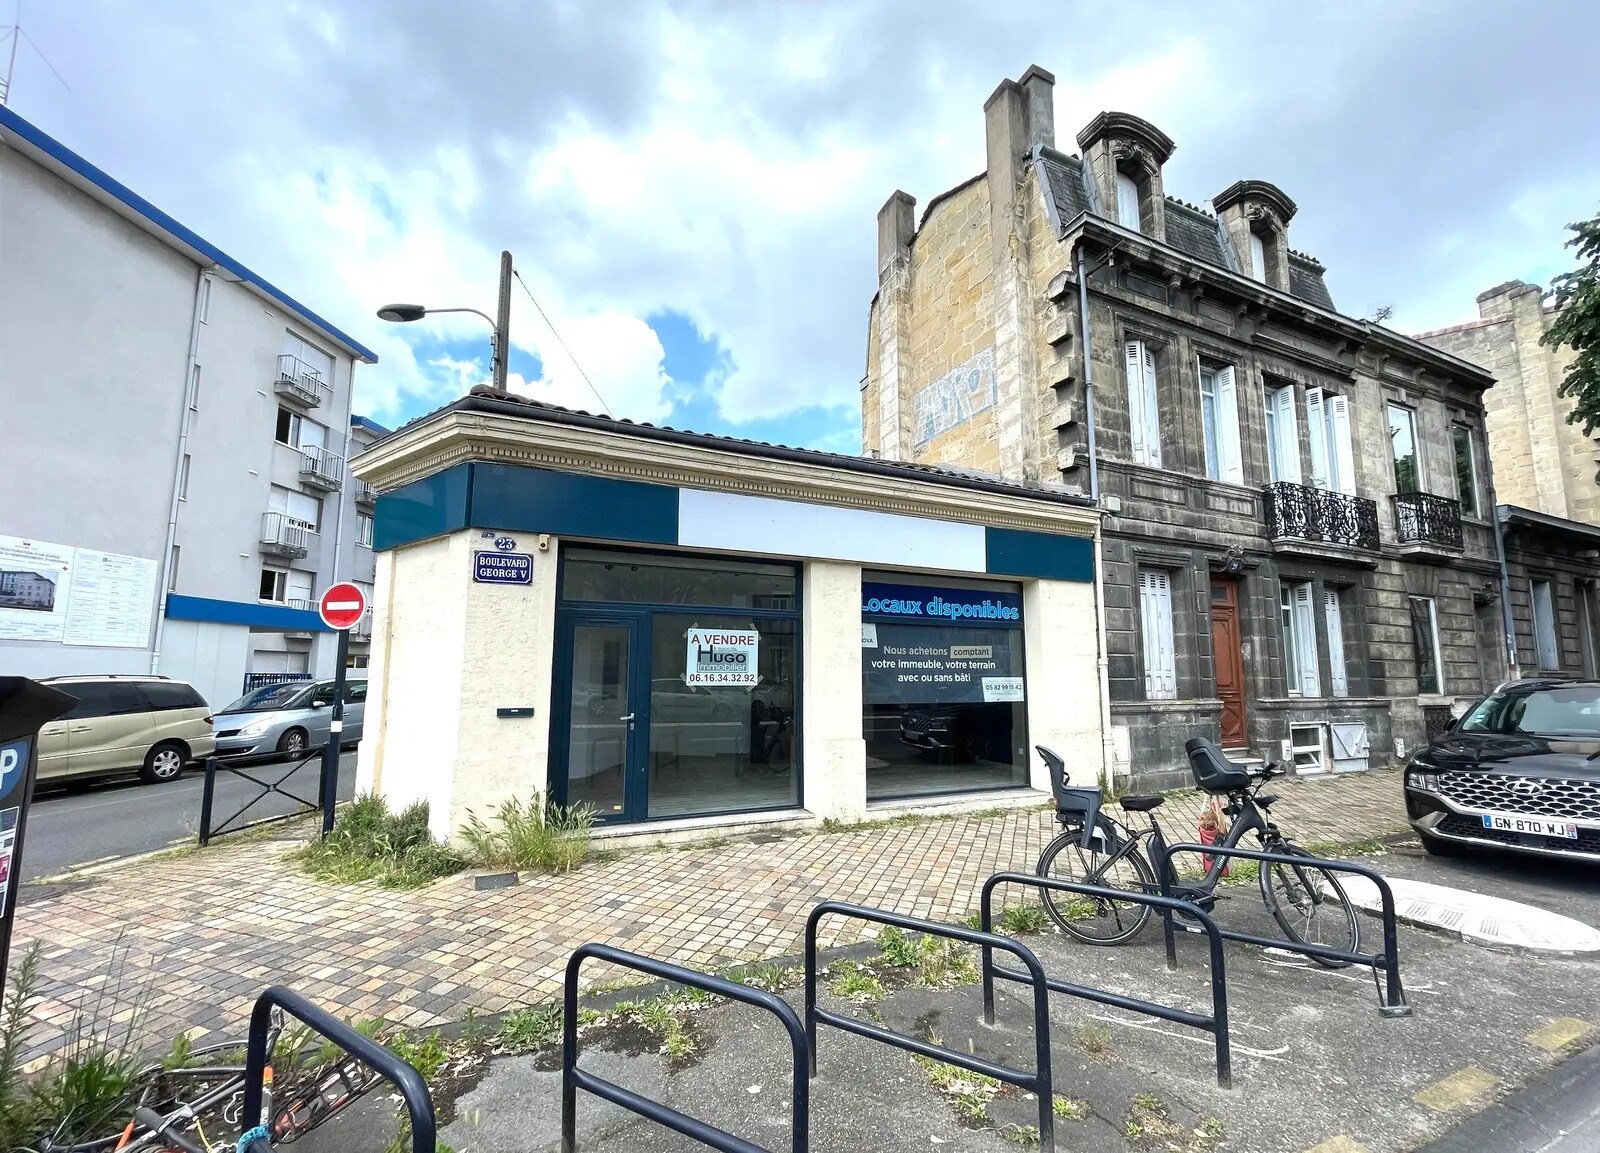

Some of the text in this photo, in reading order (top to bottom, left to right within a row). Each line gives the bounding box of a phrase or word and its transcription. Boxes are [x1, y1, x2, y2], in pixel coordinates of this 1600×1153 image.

[498, 538, 513, 550] 23
[480, 557, 528, 568] BOULEVARD
[480, 568, 528, 579] GEORGE V
[926, 596, 1020, 620] disponibles
[691, 634, 755, 646] A VENDRE
[883, 645, 990, 657] Nous achetons comptant
[697, 663, 746, 672] immobilier
[871, 659, 996, 670] votre immeuble, votre terrain
[689, 673, 755, 682] 06.16.34.32.92
[897, 672, 971, 682] avec ou sans bâti
[0, 749, 18, 790] P
